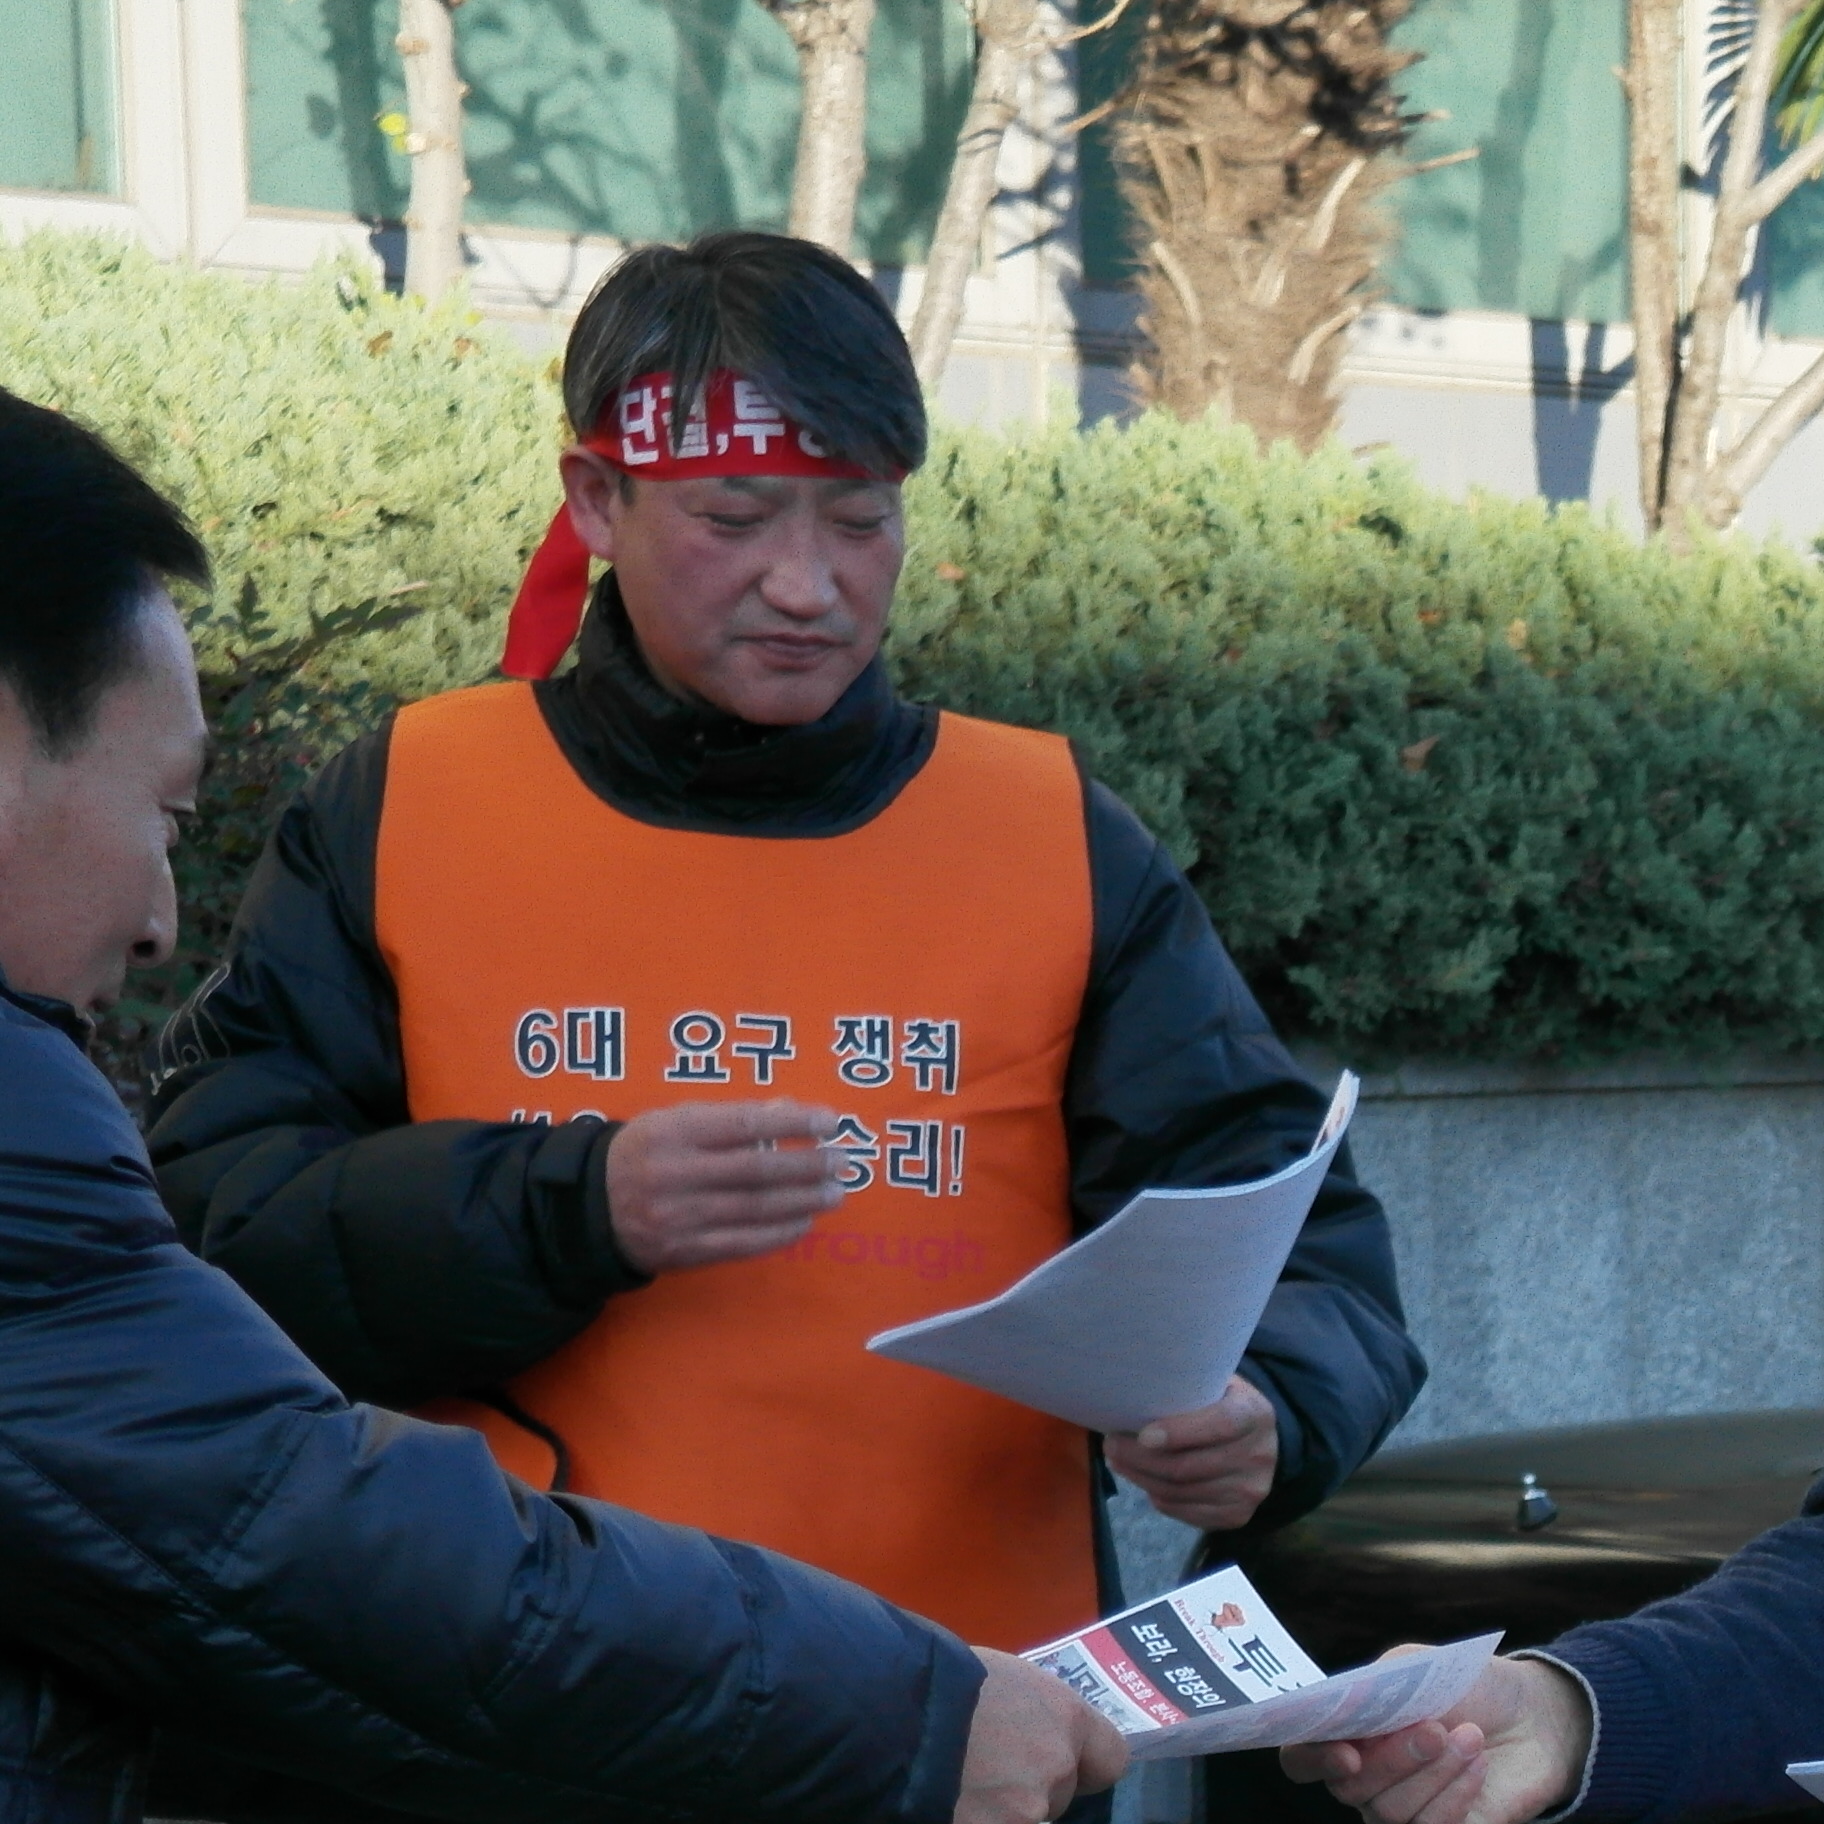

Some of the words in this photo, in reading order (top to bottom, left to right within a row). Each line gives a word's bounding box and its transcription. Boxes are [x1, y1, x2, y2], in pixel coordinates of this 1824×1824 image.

[514, 1006, 626, 1082] 6대
[664, 1010, 796, 1085] 요구
[831, 1015, 961, 1097] 쟁취
[816, 1113, 966, 1198] 승리!
[785, 1229, 986, 1281] rough
[1131, 1622, 1178, 1664] 보라,
[1164, 1665, 1227, 1709] 현장의
